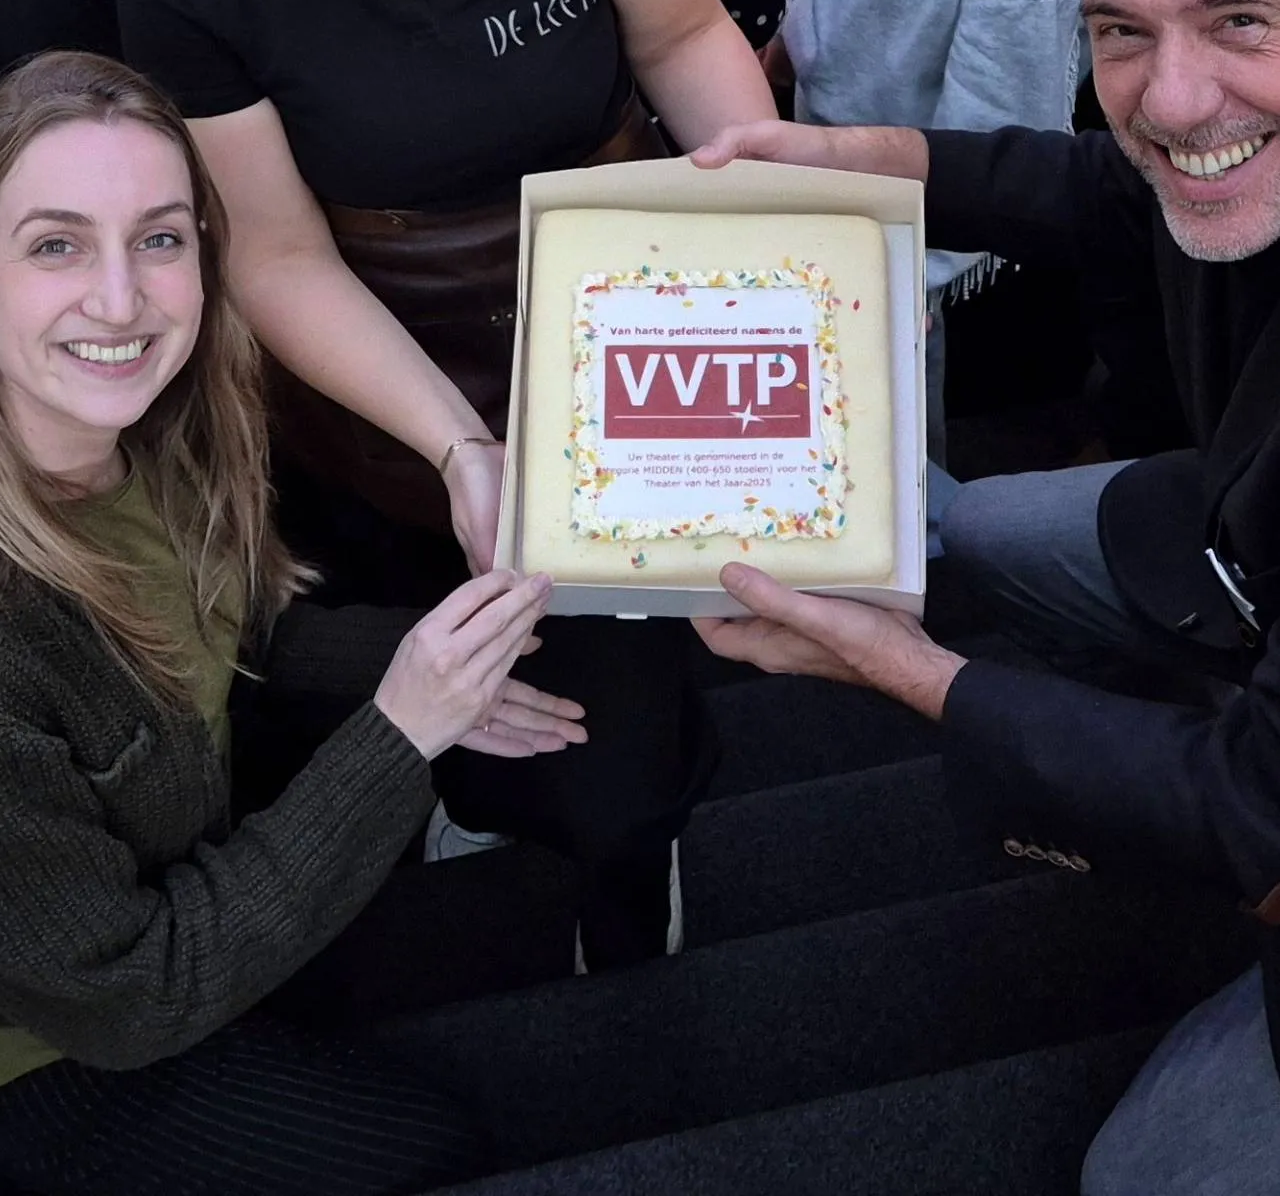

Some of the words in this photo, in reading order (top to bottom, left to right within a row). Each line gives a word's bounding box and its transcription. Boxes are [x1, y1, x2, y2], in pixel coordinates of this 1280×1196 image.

[483, 9, 525, 56] DE
[609, 326, 631, 336] Van
[635, 326, 664, 336] harte
[668, 326, 738, 337] gefeliciteerd
[789, 326, 802, 335] de
[614, 353, 798, 406] VVTP
[627, 453, 642, 461] Uw
[646, 452, 680, 461] theater
[684, 452, 691, 461] is
[694, 451, 757, 462] genomineerd
[761, 452, 769, 460] in
[772, 452, 784, 460] de
[643, 466, 682, 475] MIDDEN
[734, 465, 773, 475] stoelen)
[800, 465, 817, 473] het
[644, 479, 681, 488] Theater
[685, 480, 702, 488] van
[705, 479, 720, 487] het
[746, 478, 772, 487] 2025
